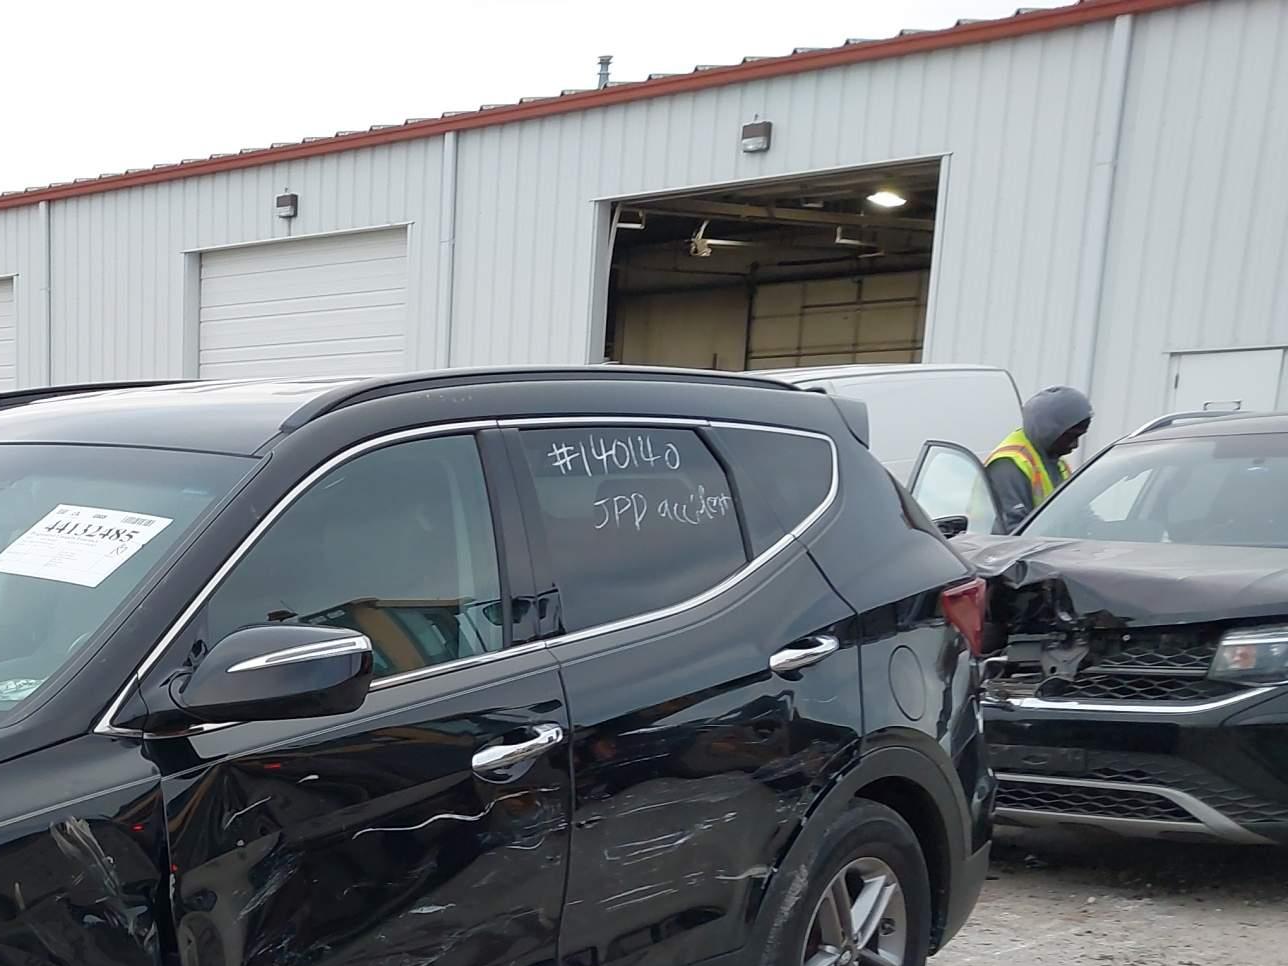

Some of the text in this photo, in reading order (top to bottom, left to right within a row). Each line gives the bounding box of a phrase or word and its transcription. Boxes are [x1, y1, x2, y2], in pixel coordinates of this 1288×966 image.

[547, 434, 681, 477] #140140
[44, 519, 140, 543] 44132485
[593, 492, 648, 531] JPD
